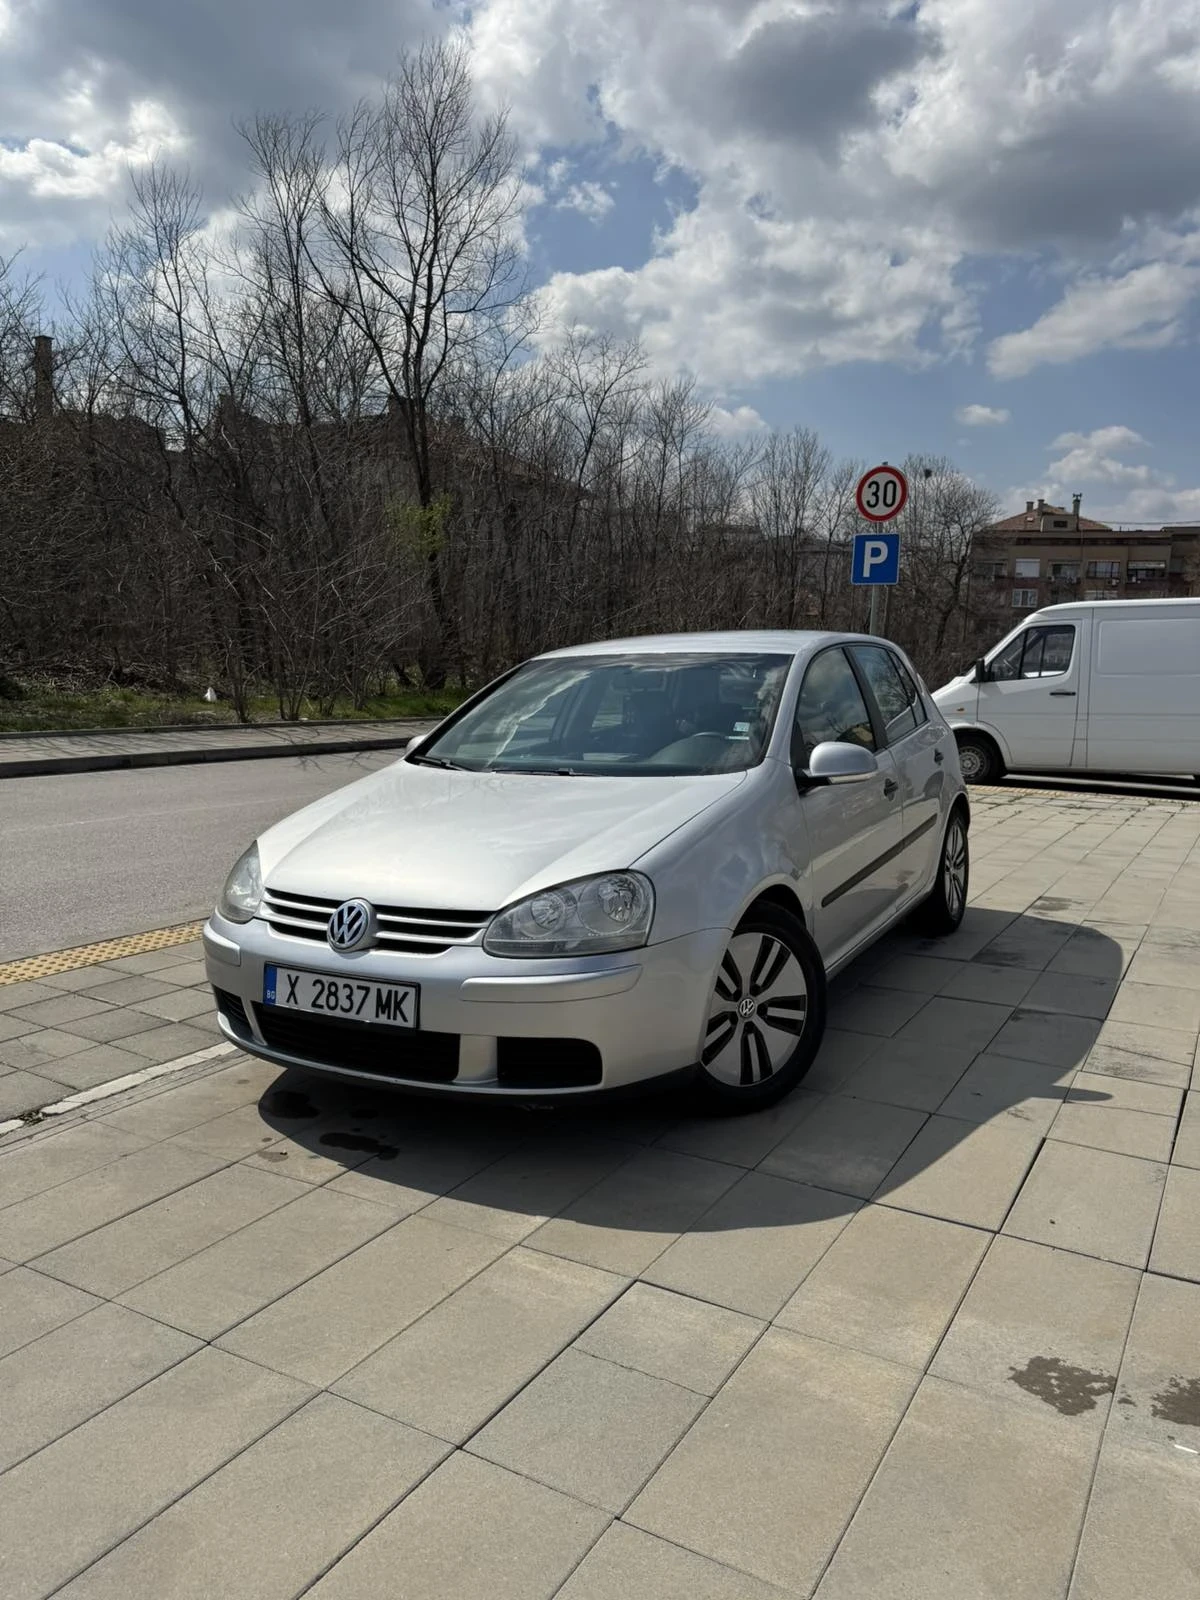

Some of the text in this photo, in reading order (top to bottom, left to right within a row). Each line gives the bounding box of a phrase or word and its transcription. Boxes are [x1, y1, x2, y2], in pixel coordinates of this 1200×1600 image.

[866, 480, 897, 508] 30
[863, 541, 888, 577] P
[329, 901, 369, 950] VW
[286, 974, 409, 1023] X 2837 MK
